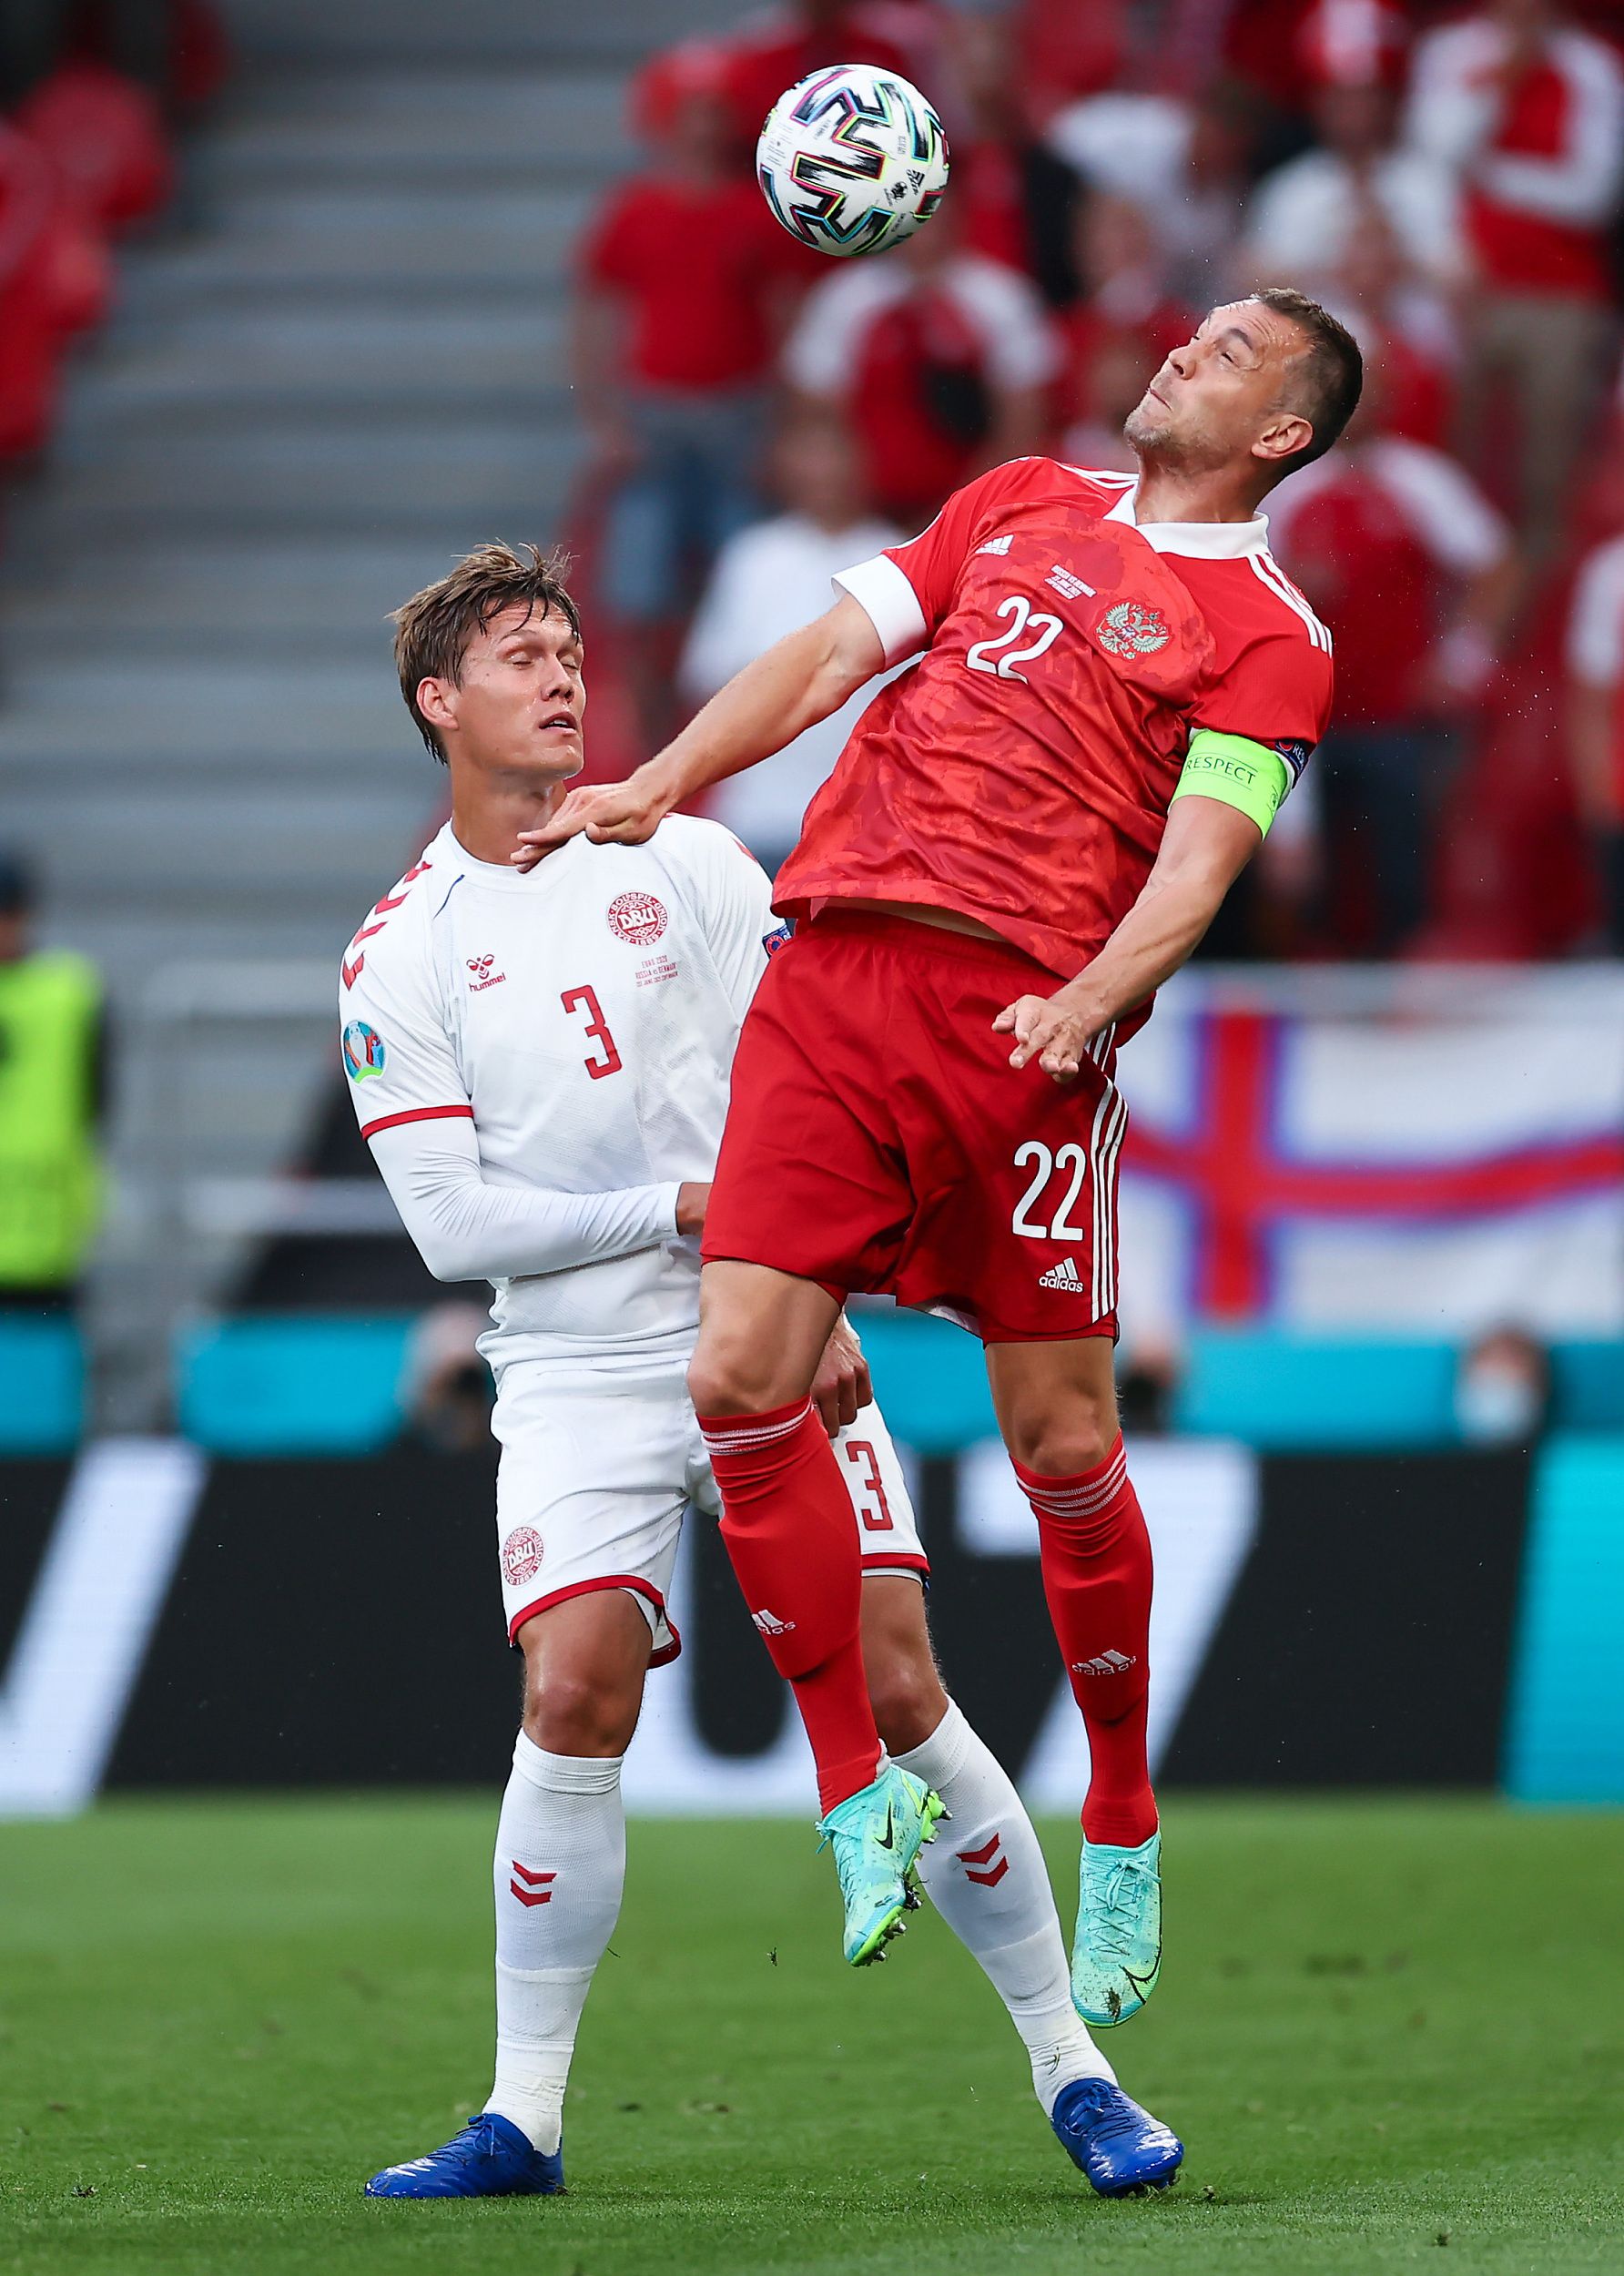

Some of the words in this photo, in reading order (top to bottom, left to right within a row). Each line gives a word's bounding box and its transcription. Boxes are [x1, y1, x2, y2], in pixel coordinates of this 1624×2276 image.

[966, 594, 1064, 686] 22
[1184, 757, 1256, 785] RESPECT
[618, 906, 657, 930] DBU
[469, 972, 506, 992] hummel
[561, 985, 623, 1080] 3
[1012, 1141, 1086, 1241] 22
[1039, 1275, 1084, 1294] adidas
[846, 1441, 894, 1530] 3
[1072, 1655, 1137, 1676] adidas
